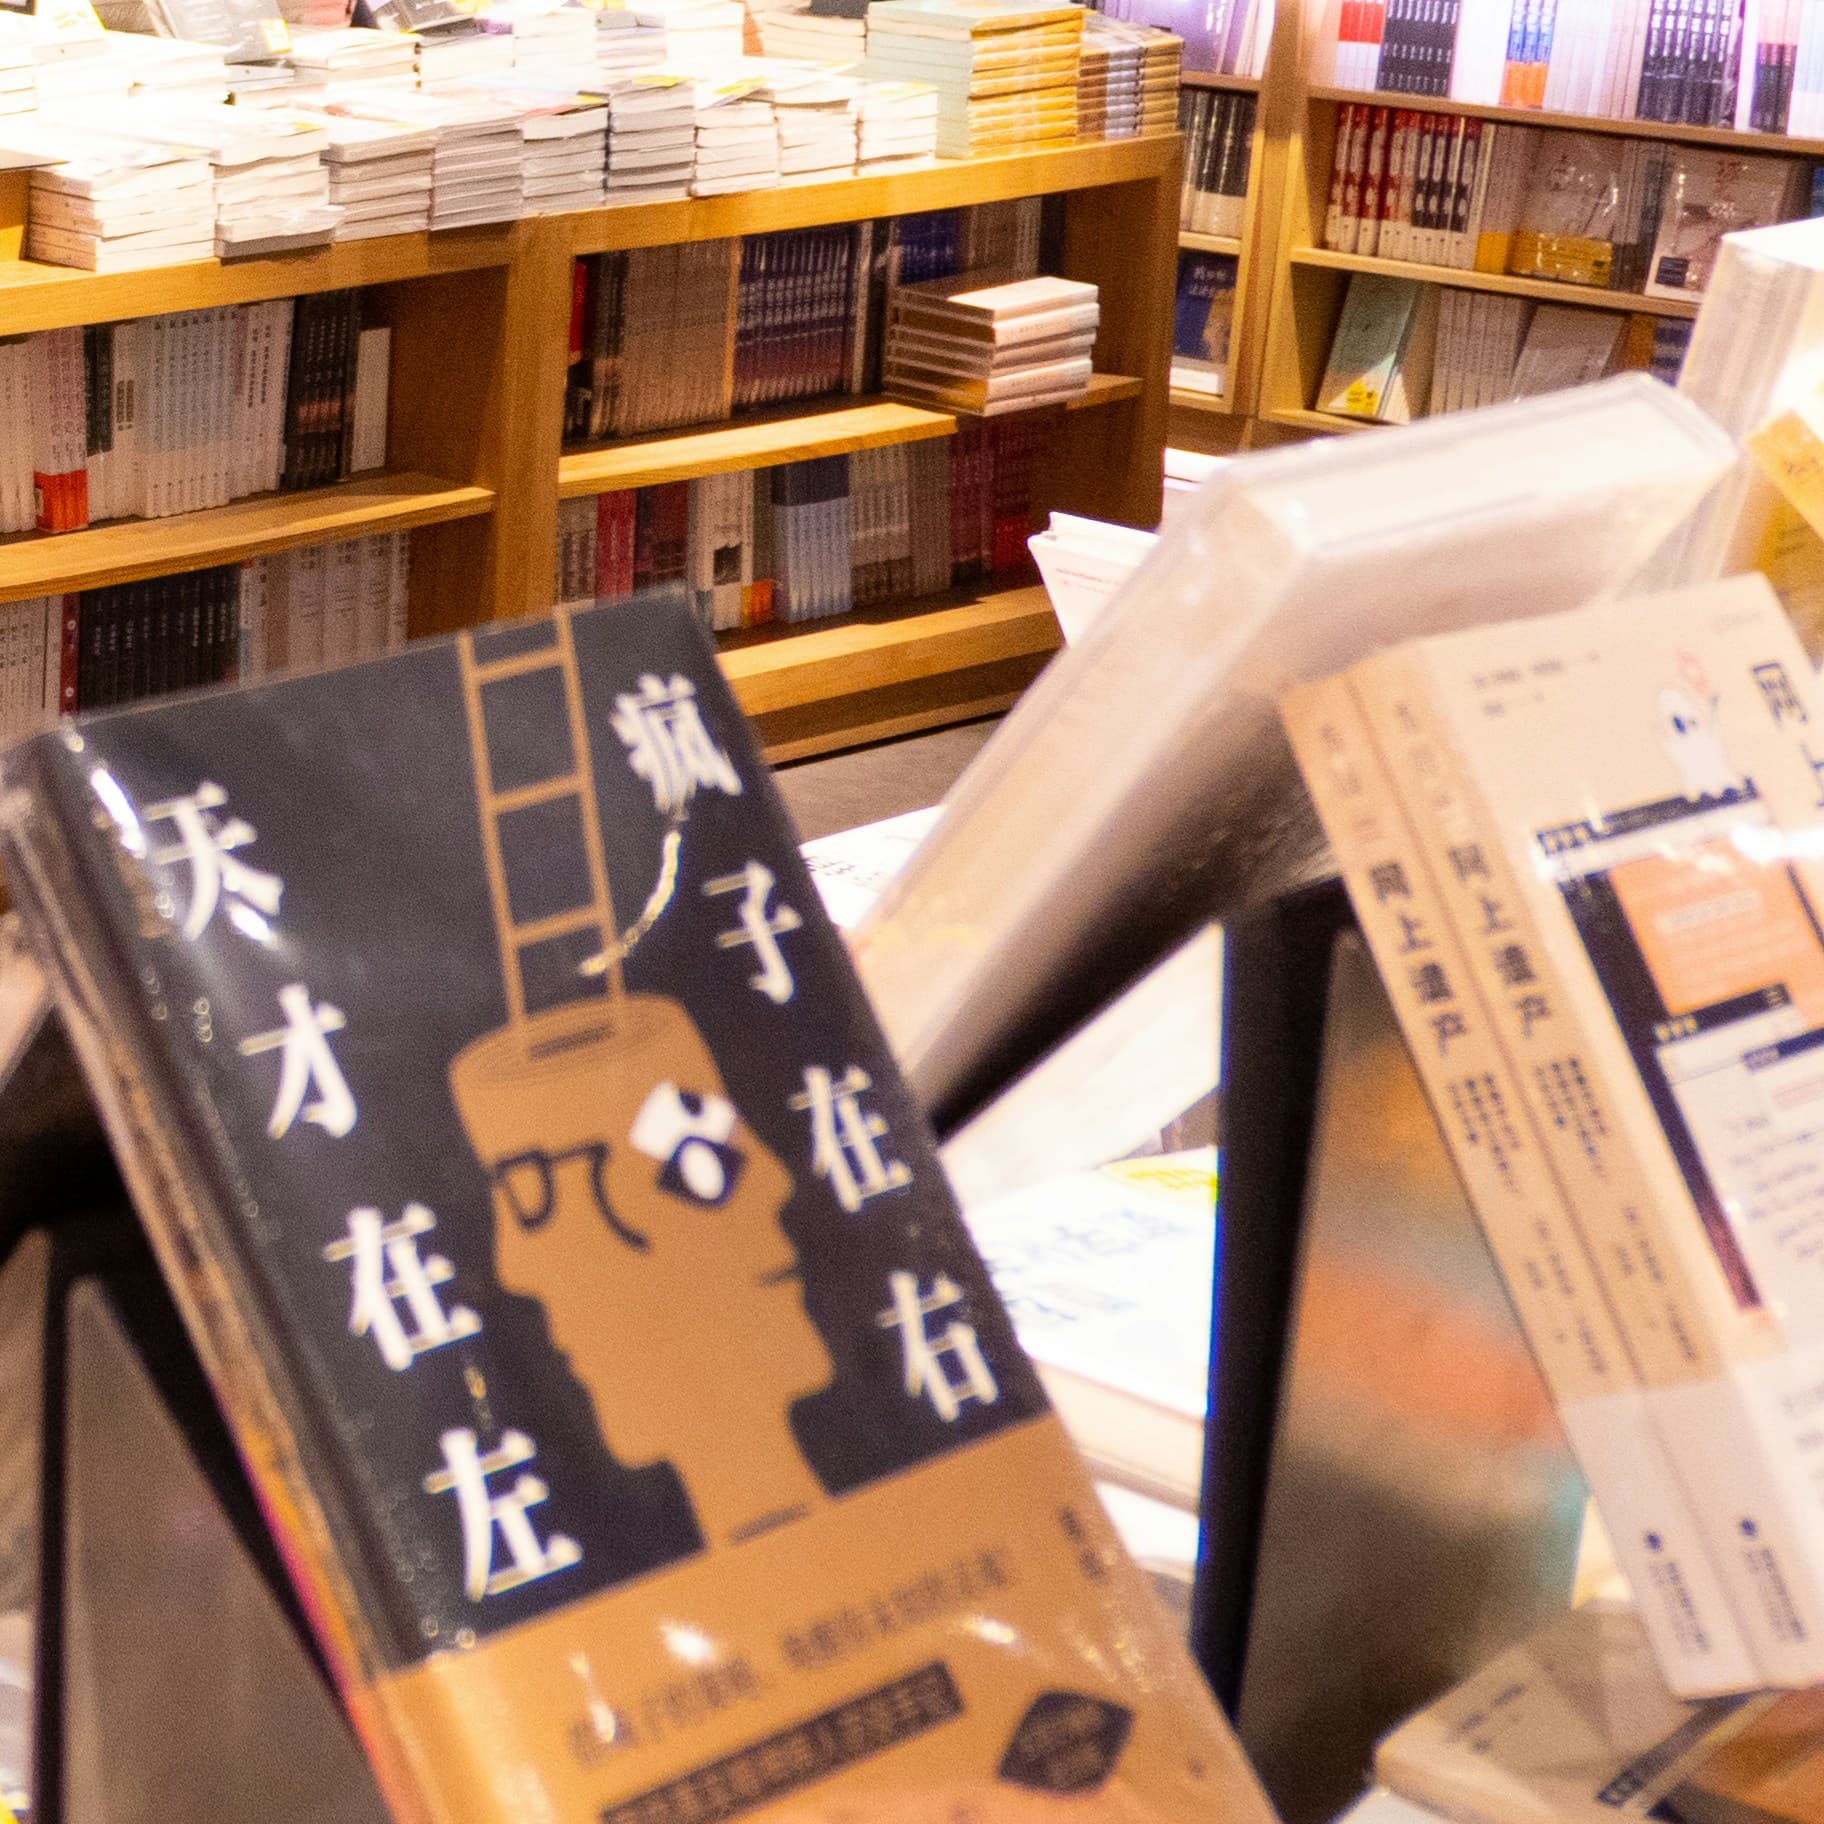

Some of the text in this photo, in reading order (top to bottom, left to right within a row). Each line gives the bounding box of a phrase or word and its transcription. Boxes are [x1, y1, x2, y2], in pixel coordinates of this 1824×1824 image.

[148, 780, 584, 1601] 天才在左
[611, 670, 1000, 1424] 疯子在右
